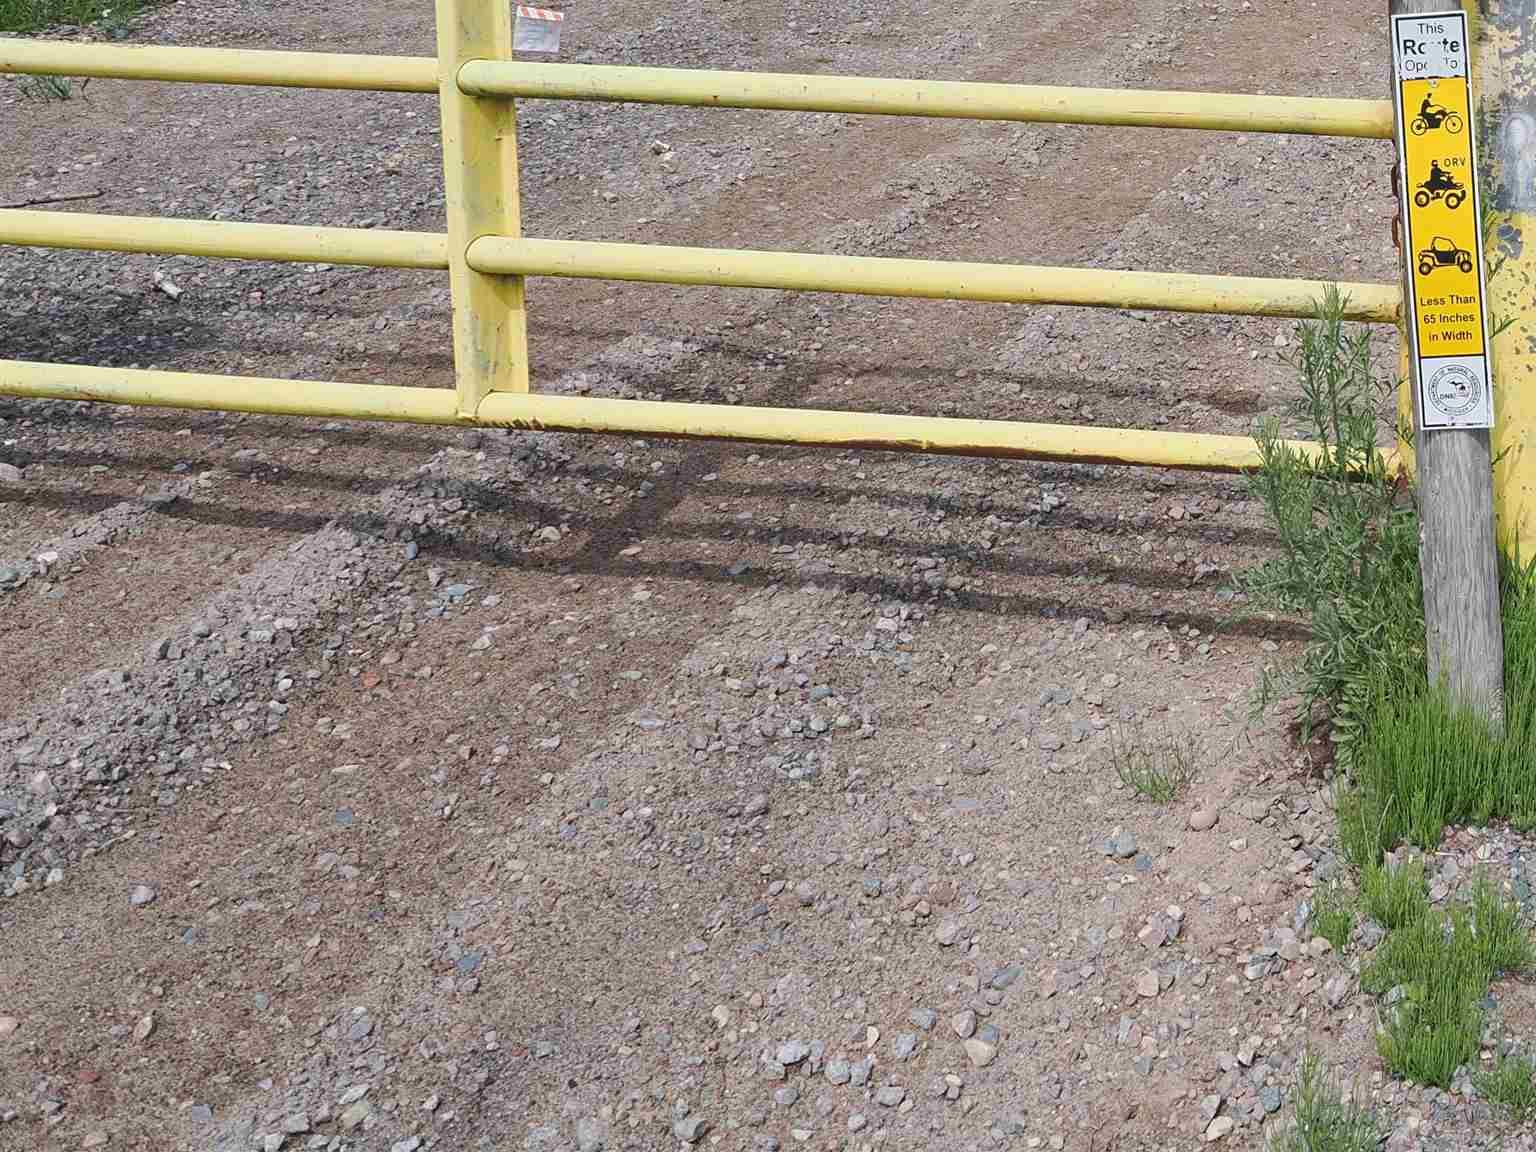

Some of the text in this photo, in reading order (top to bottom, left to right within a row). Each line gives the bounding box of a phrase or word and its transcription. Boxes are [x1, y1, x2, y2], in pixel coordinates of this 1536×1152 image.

[1417, 23, 1444, 34] This
[1403, 38, 1460, 56] Rote
[1443, 157, 1465, 168] ORV
[1420, 294, 1476, 306] Less Than
[1423, 312, 1475, 324] 65 Inches
[1429, 330, 1472, 342] in Width
